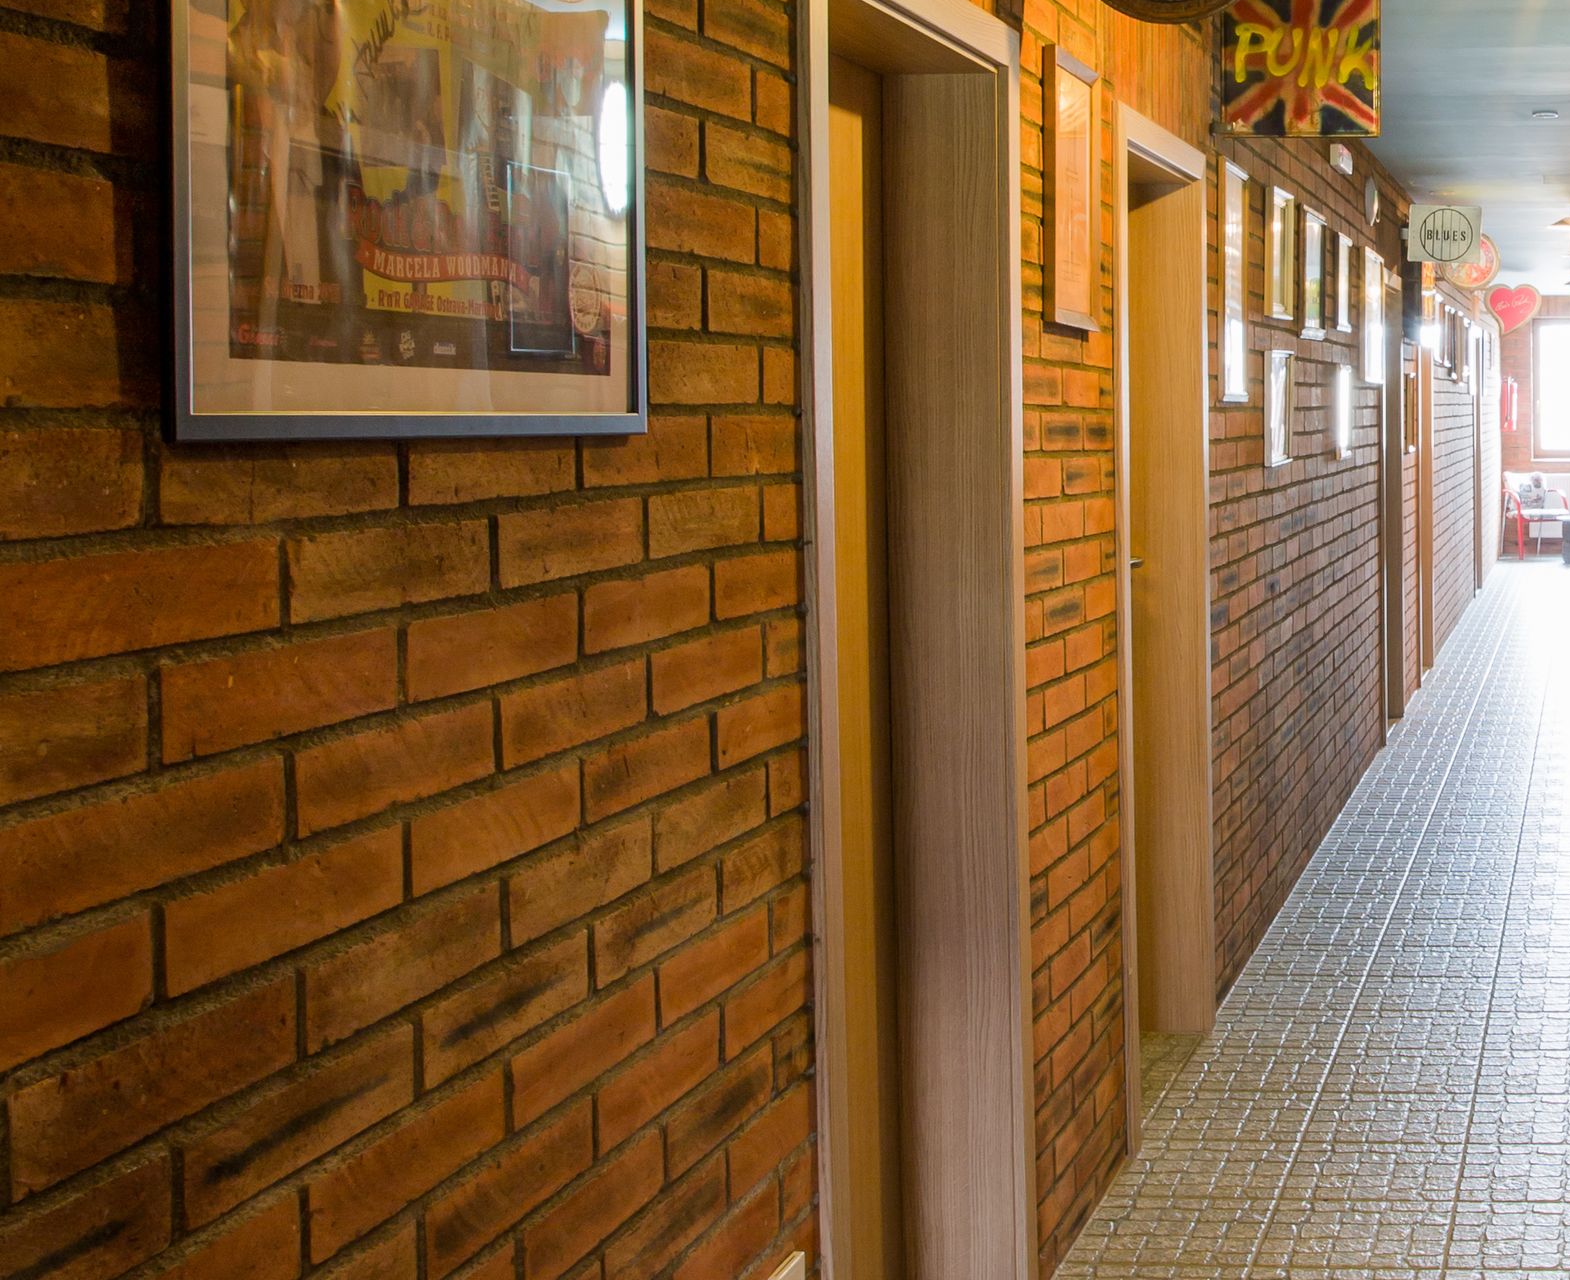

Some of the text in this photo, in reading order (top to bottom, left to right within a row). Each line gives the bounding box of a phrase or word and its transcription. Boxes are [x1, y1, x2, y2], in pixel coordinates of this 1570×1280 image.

[1234, 23, 1375, 91] PUNK
[1426, 229, 1467, 242] BLUES
[373, 248, 440, 278] MARCELA
